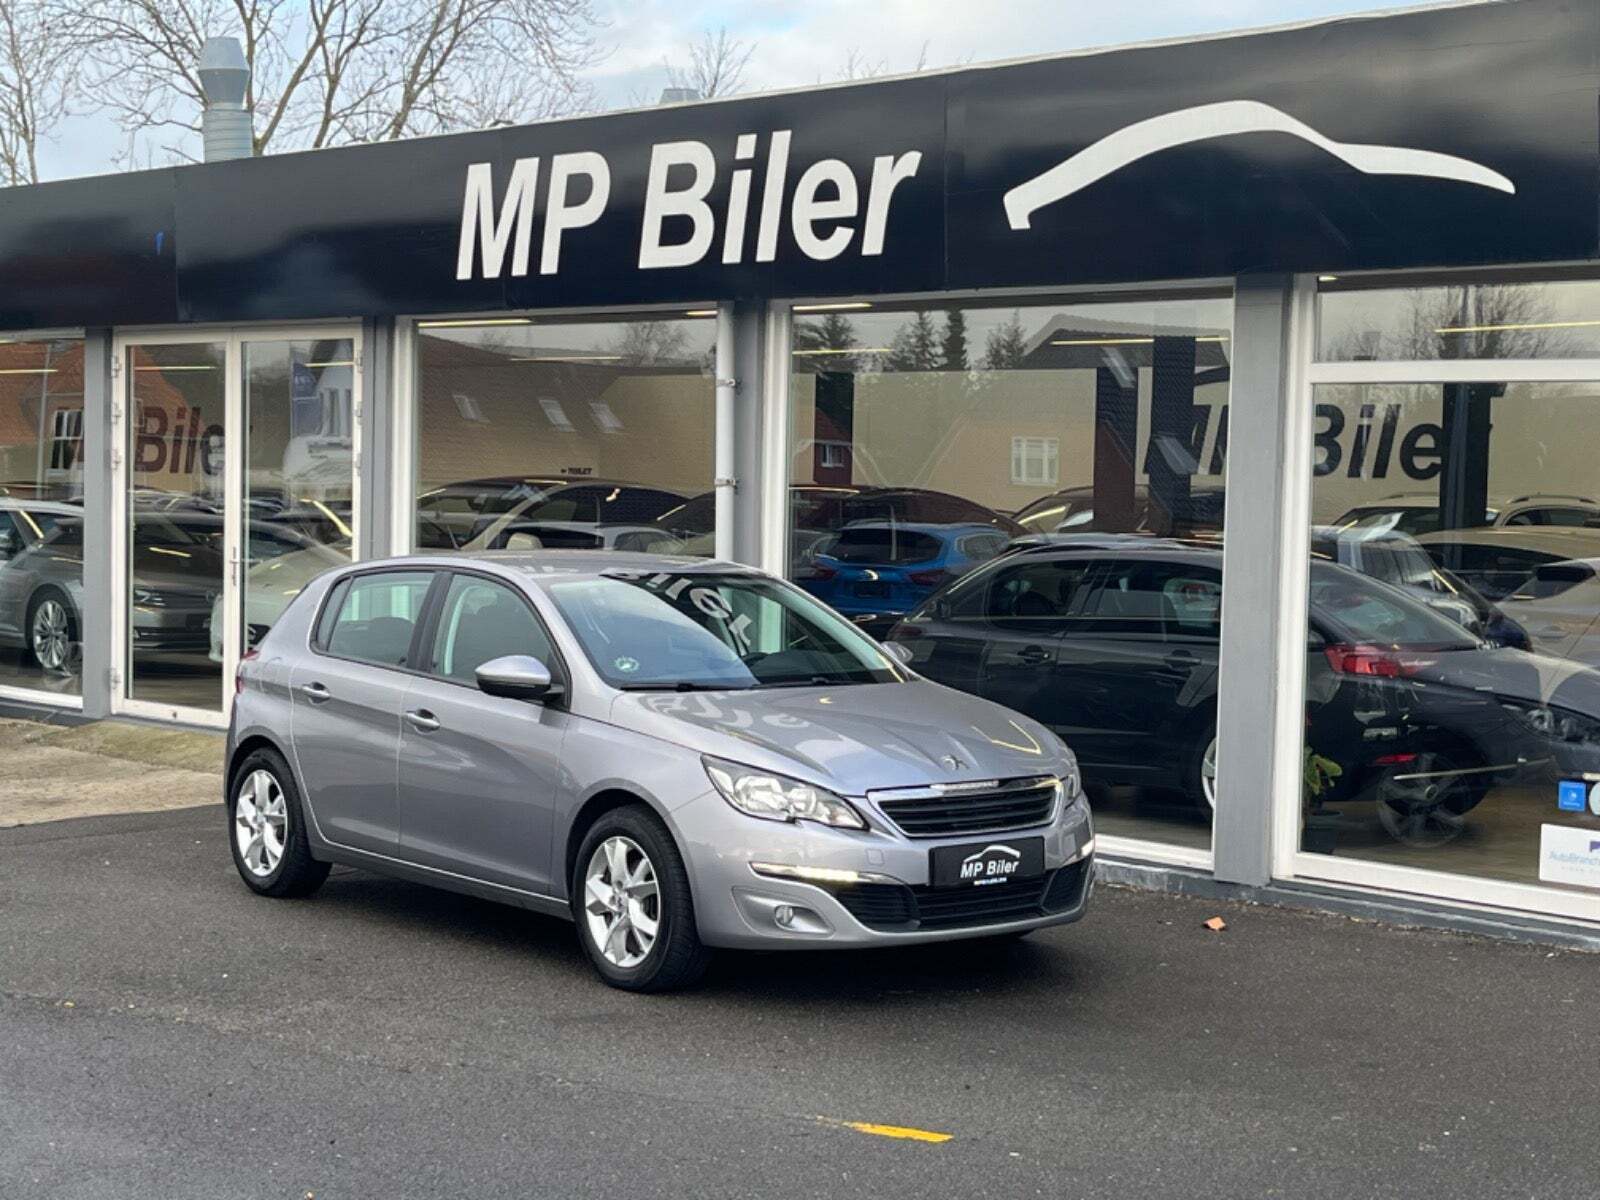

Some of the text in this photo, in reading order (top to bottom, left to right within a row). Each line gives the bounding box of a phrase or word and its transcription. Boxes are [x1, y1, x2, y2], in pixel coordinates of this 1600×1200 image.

[456, 130, 922, 281] MP Biler
[136, 407, 224, 476] Bile
[1314, 404, 1443, 480] Bile
[960, 860, 1019, 878] MP Biler
